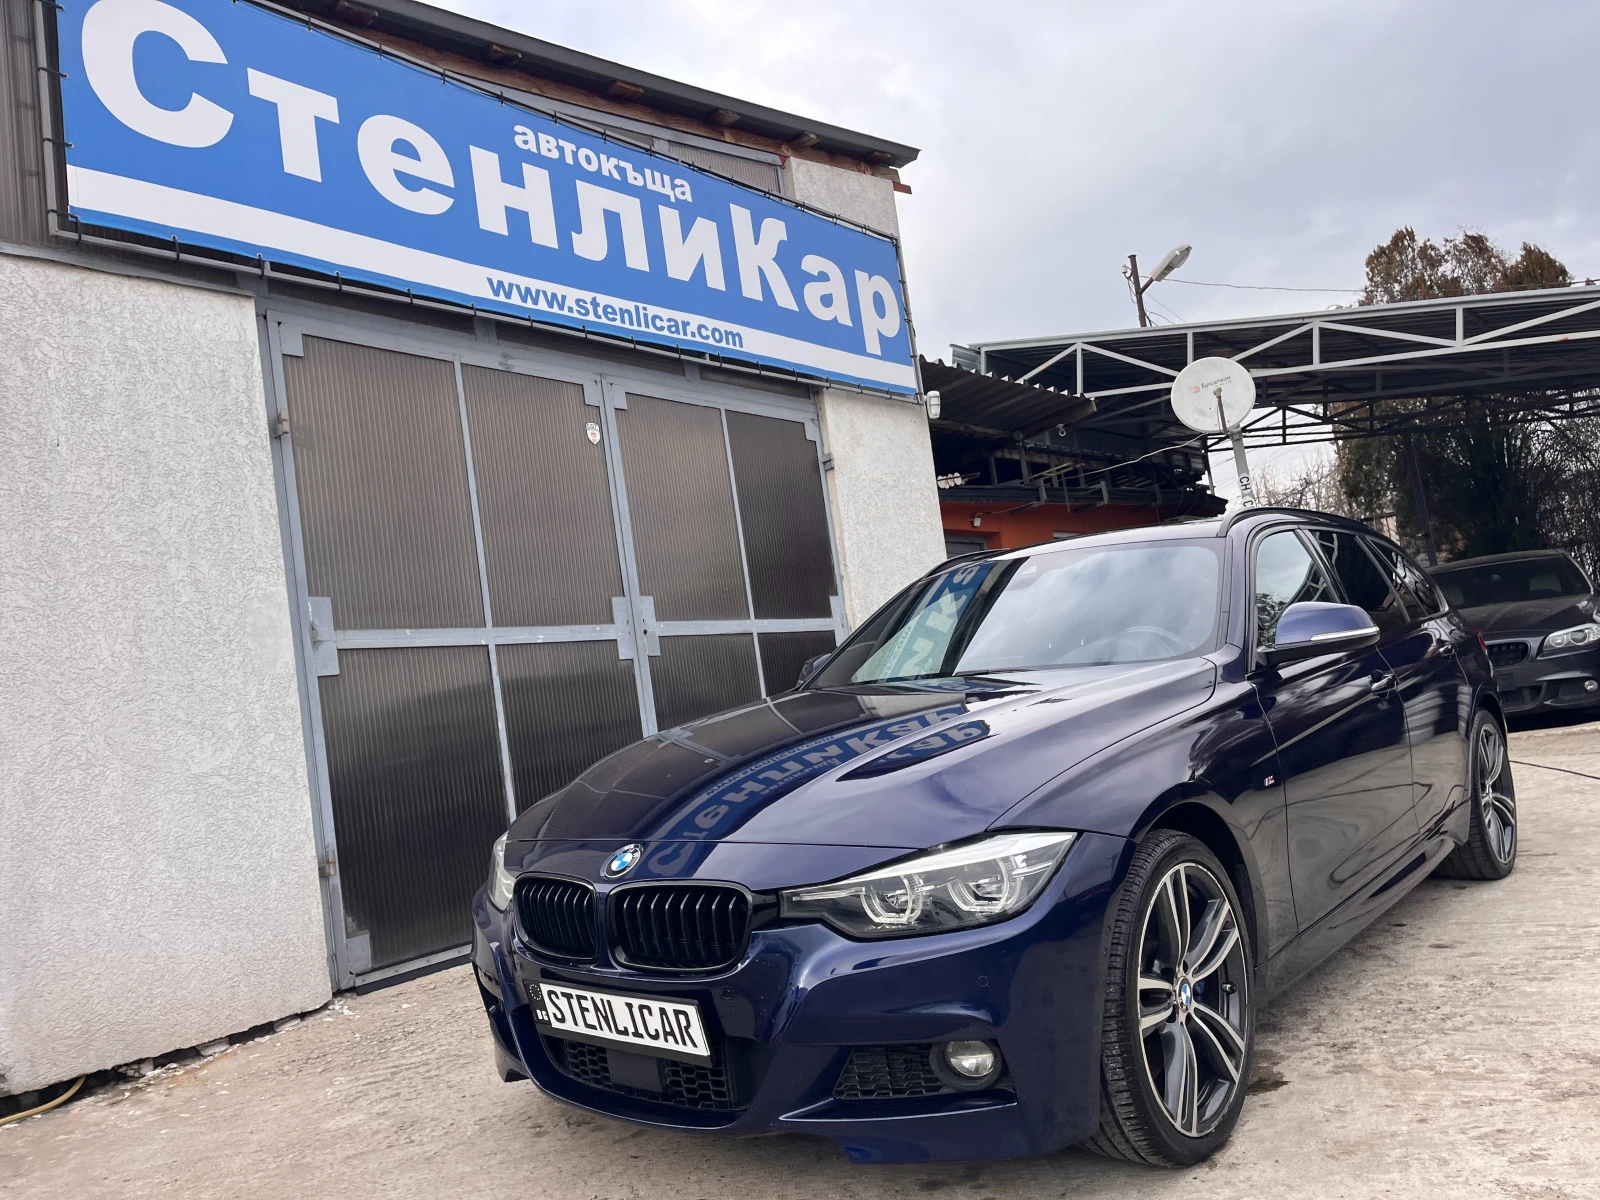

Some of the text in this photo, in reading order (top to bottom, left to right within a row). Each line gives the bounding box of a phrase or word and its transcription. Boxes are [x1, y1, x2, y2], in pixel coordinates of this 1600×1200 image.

[82, 0, 900, 355] СтенлиКар
[513, 125, 692, 202] автокъща
[486, 277, 744, 348] www.stenlicar.com
[536, 1009, 549, 1021] BG
[546, 989, 698, 1049] STENLICAR
